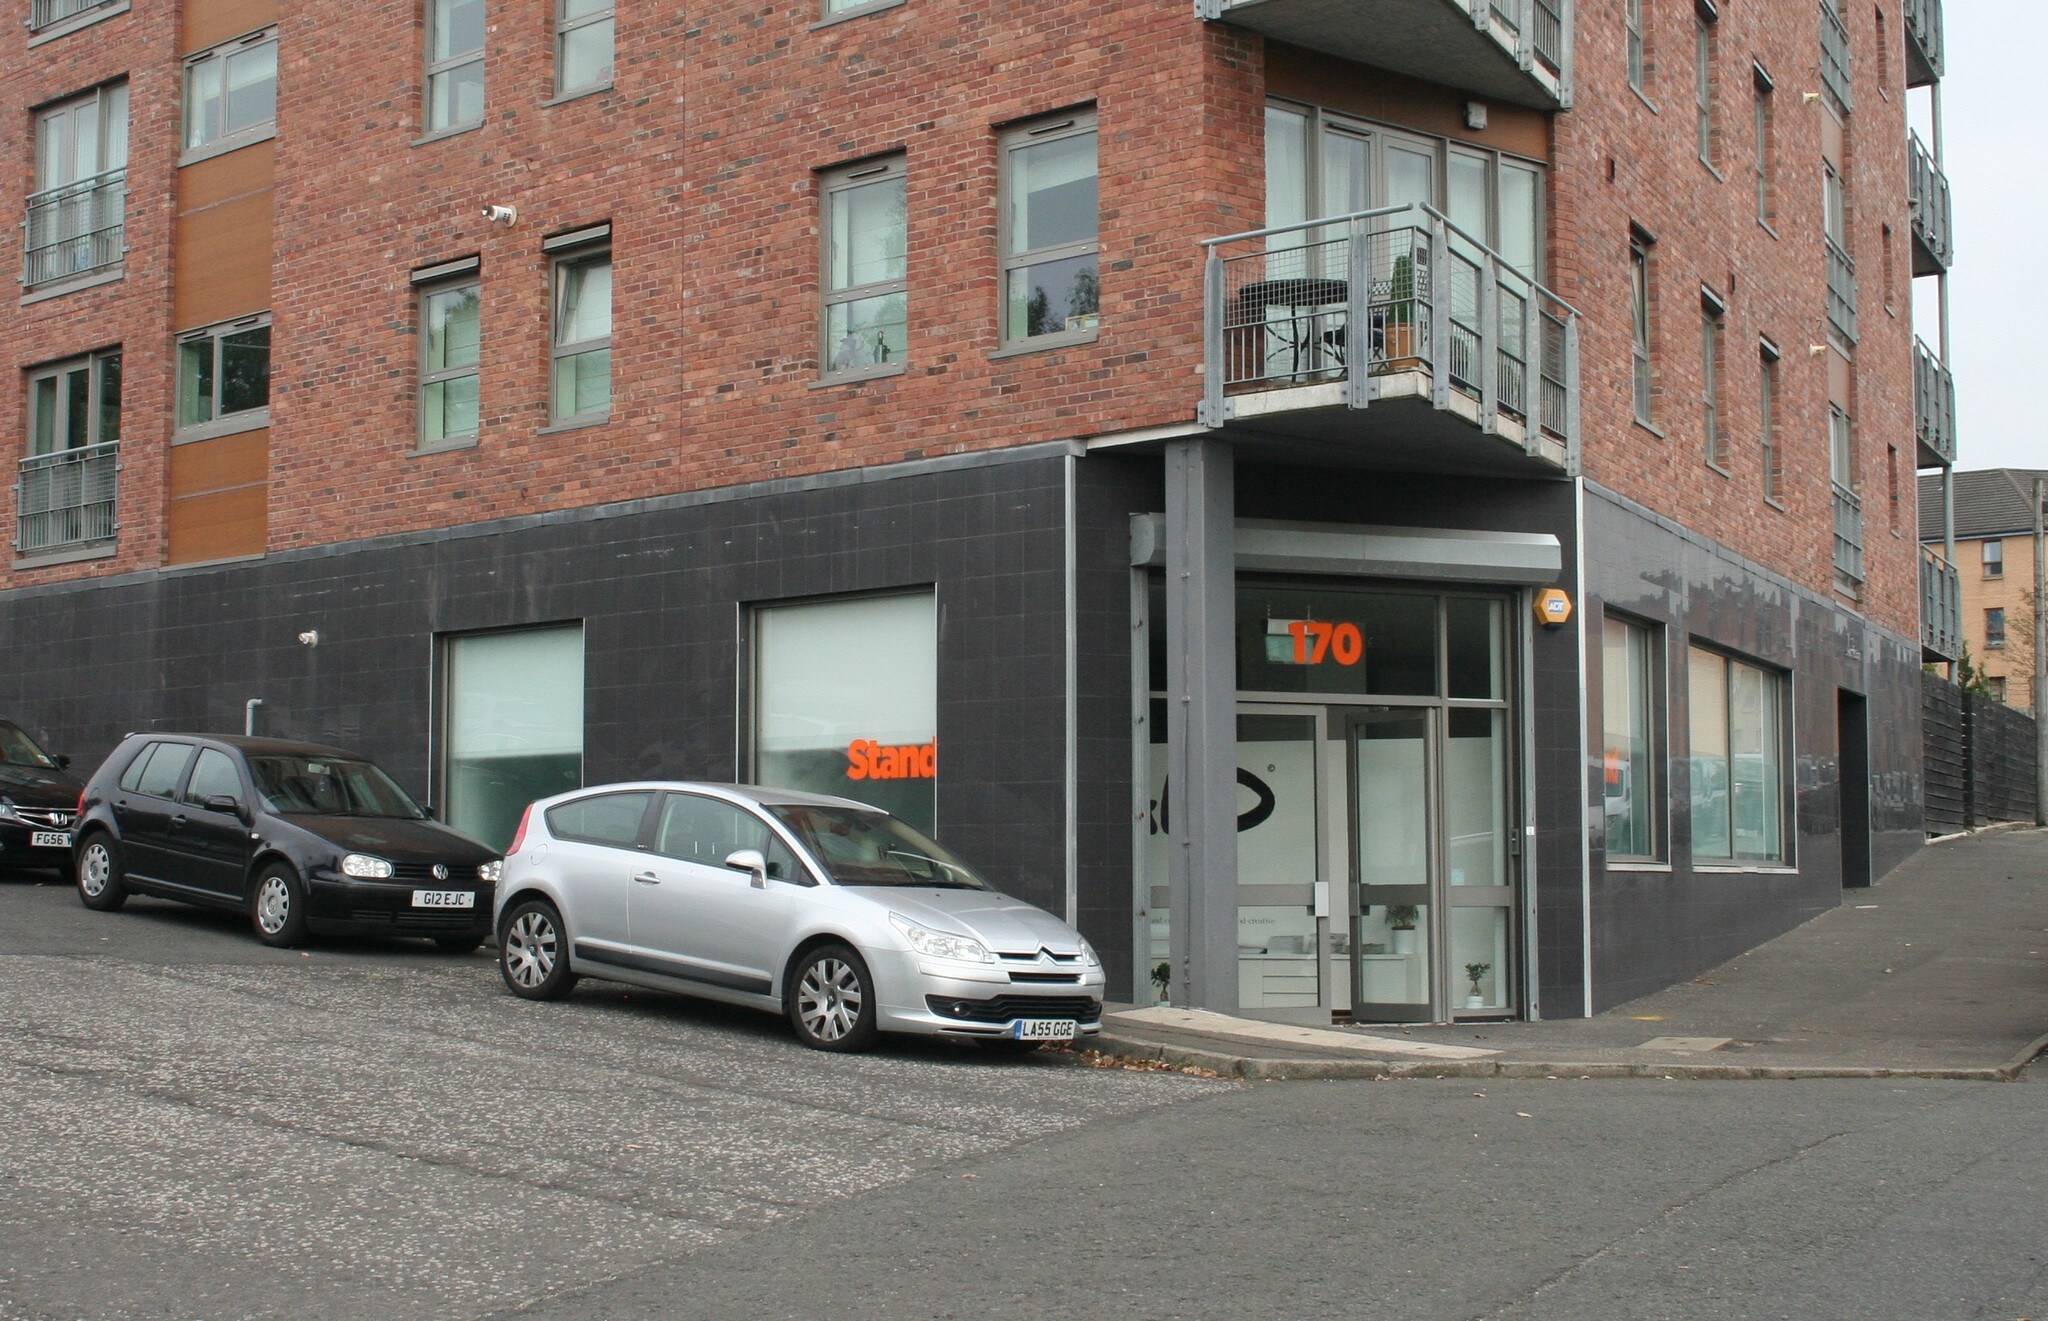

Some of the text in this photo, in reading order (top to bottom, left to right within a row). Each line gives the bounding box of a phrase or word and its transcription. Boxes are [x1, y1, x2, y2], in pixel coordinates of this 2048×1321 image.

[1287, 621, 1362, 666] 170
[845, 736, 936, 780] Stand
[36, 833, 64, 845] FG56
[444, 893, 465, 905] EJC
[1022, 1021, 1074, 1036] LA55 GGE
